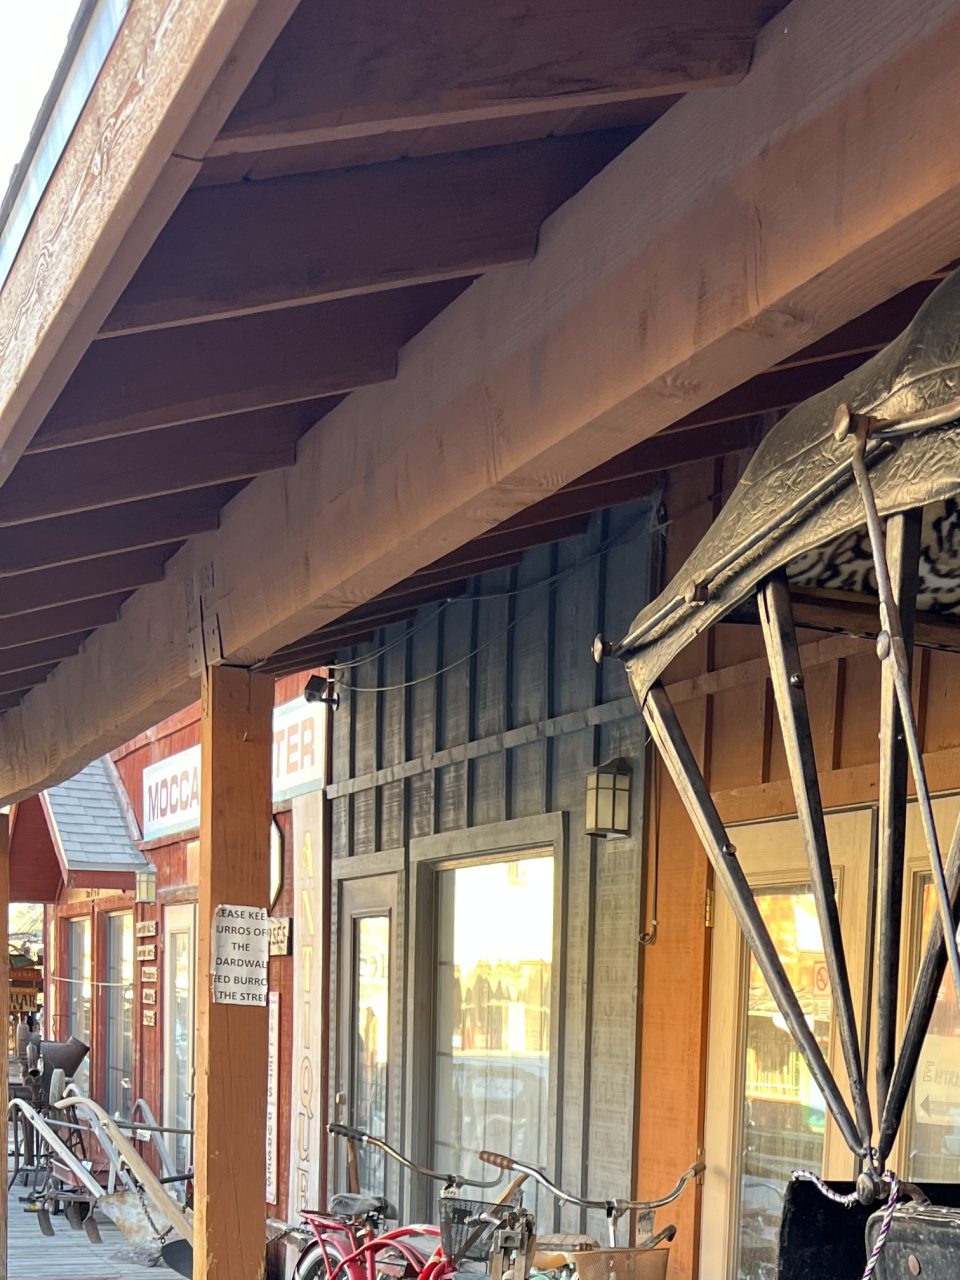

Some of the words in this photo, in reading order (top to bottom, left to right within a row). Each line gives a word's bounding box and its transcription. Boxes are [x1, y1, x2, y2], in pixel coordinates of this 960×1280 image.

[274, 717, 315, 780] TER
[148, 766, 200, 822] MOCCA
[248, 911, 266, 920] KEE
[232, 942, 250, 952] THE
[215, 956, 268, 969] OARDWAL
[218, 990, 238, 1000] THE
